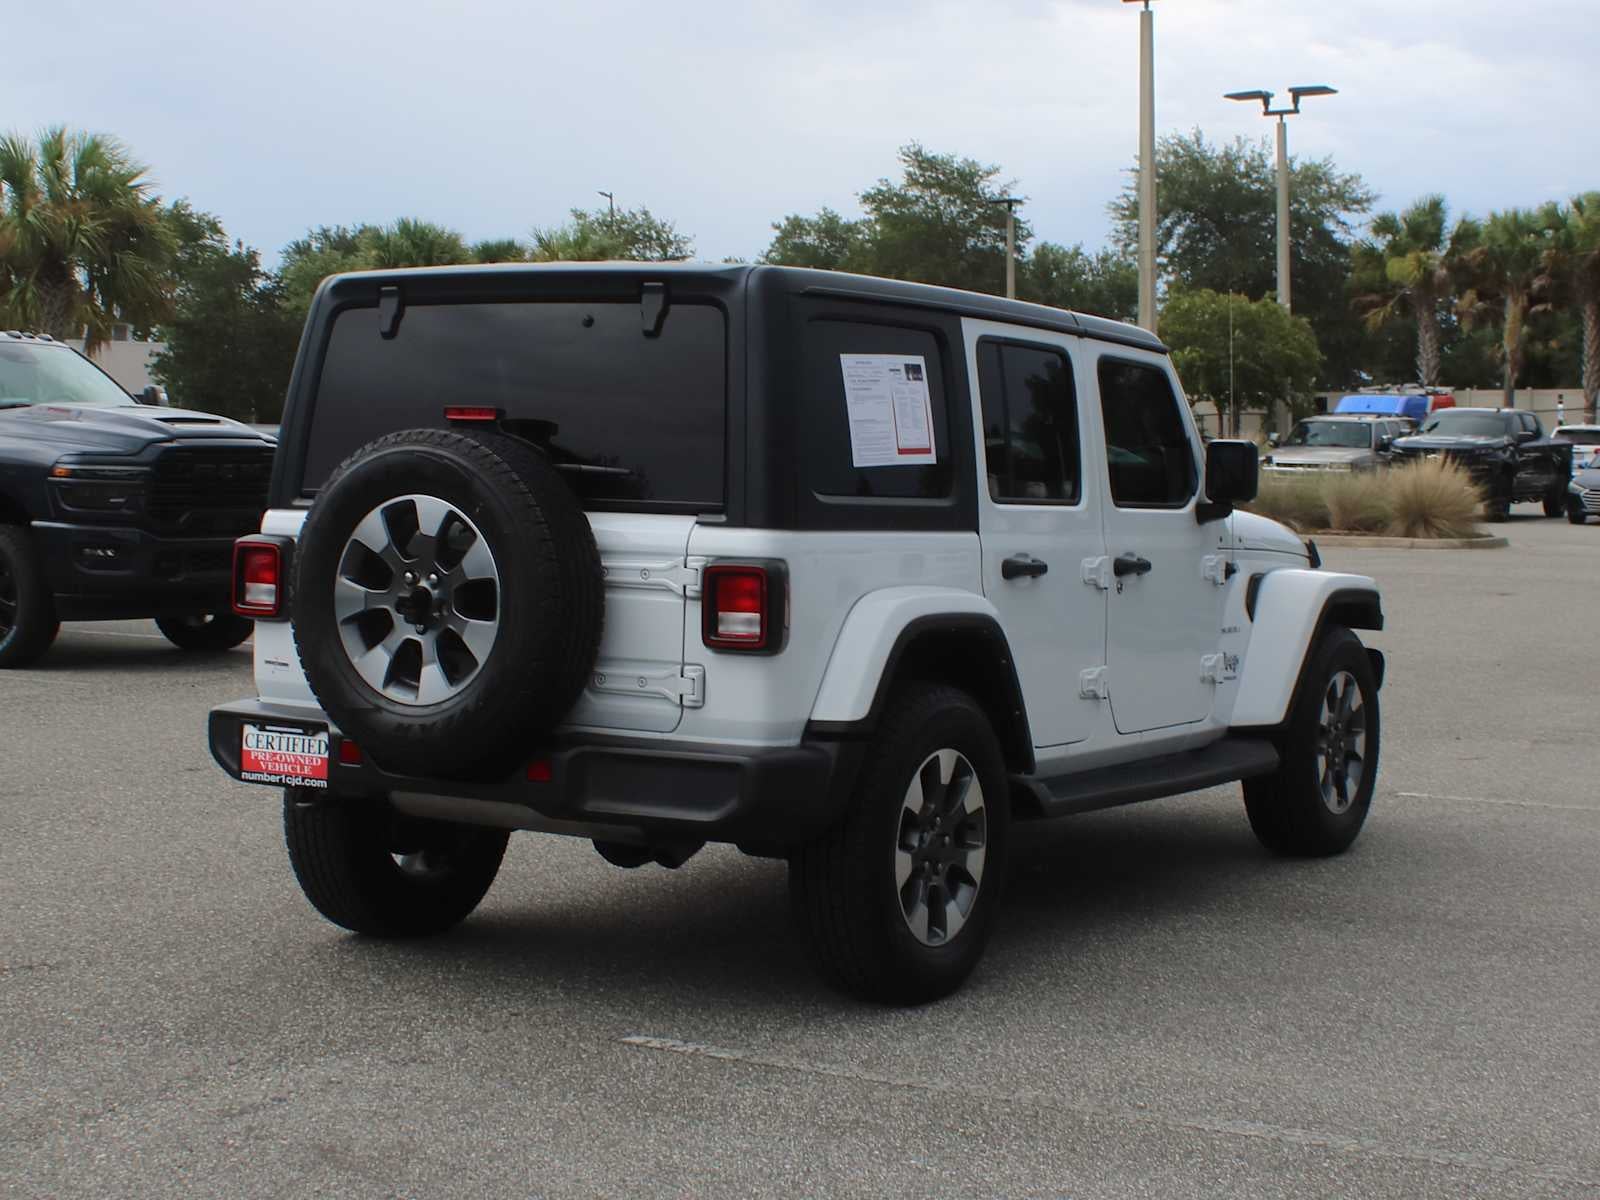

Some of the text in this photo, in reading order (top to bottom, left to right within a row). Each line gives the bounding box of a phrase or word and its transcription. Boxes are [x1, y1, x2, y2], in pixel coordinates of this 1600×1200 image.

[245, 733, 329, 755] CERTIFIED
[250, 751, 321, 766] PRE-OWNED
[260, 761, 313, 775] VEHICLE
